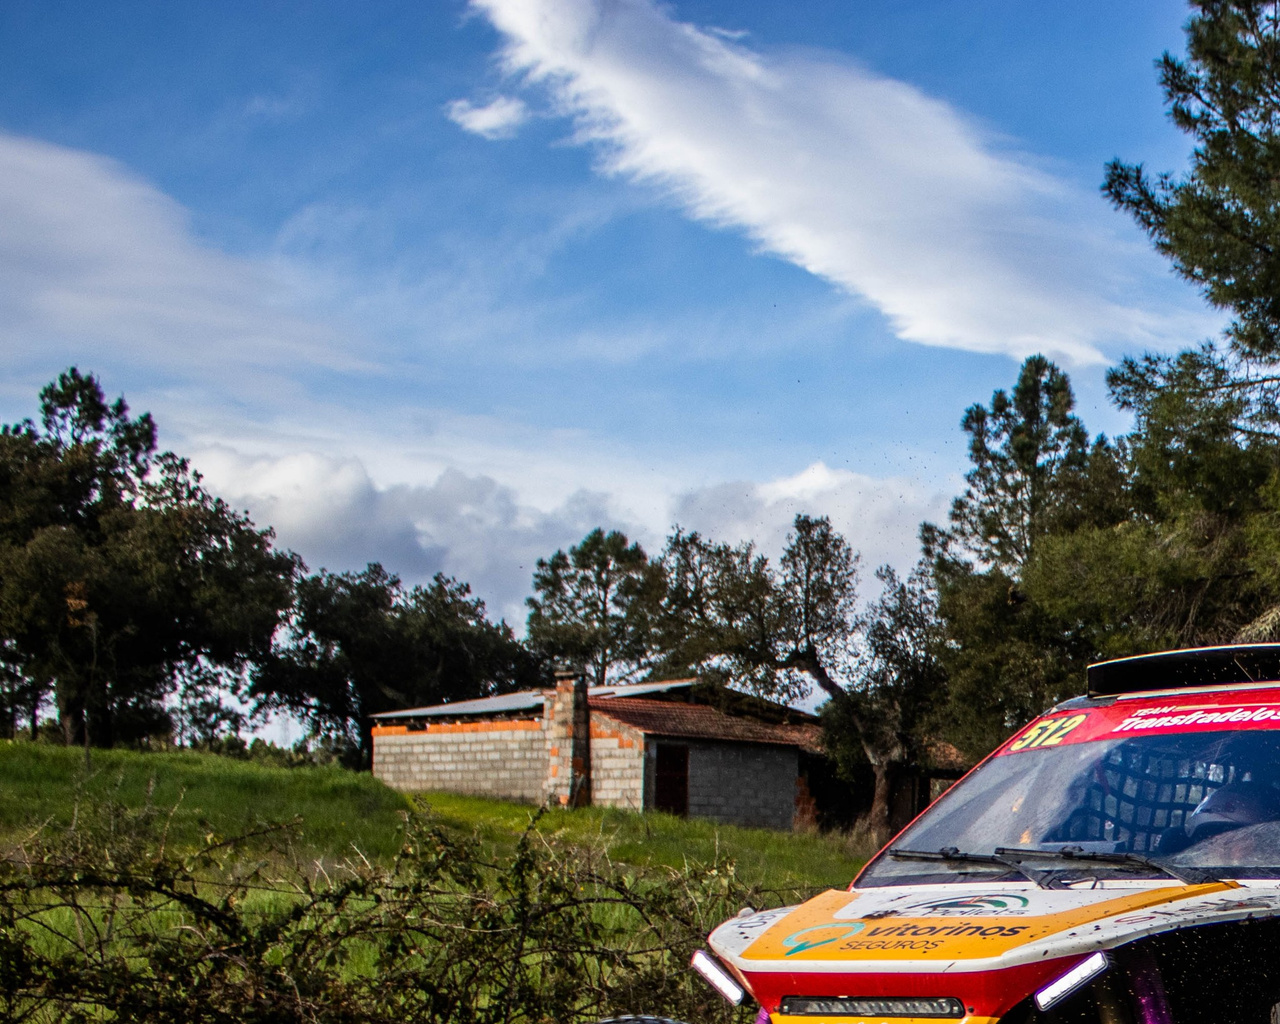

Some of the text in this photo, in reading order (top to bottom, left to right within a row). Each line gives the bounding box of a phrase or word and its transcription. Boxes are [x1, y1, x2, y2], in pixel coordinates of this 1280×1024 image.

[1131, 705, 1176, 718] TEAM
[1009, 713, 1088, 752] 512
[866, 921, 1031, 937] vitorinos
[839, 940, 945, 951] SEGUROS
